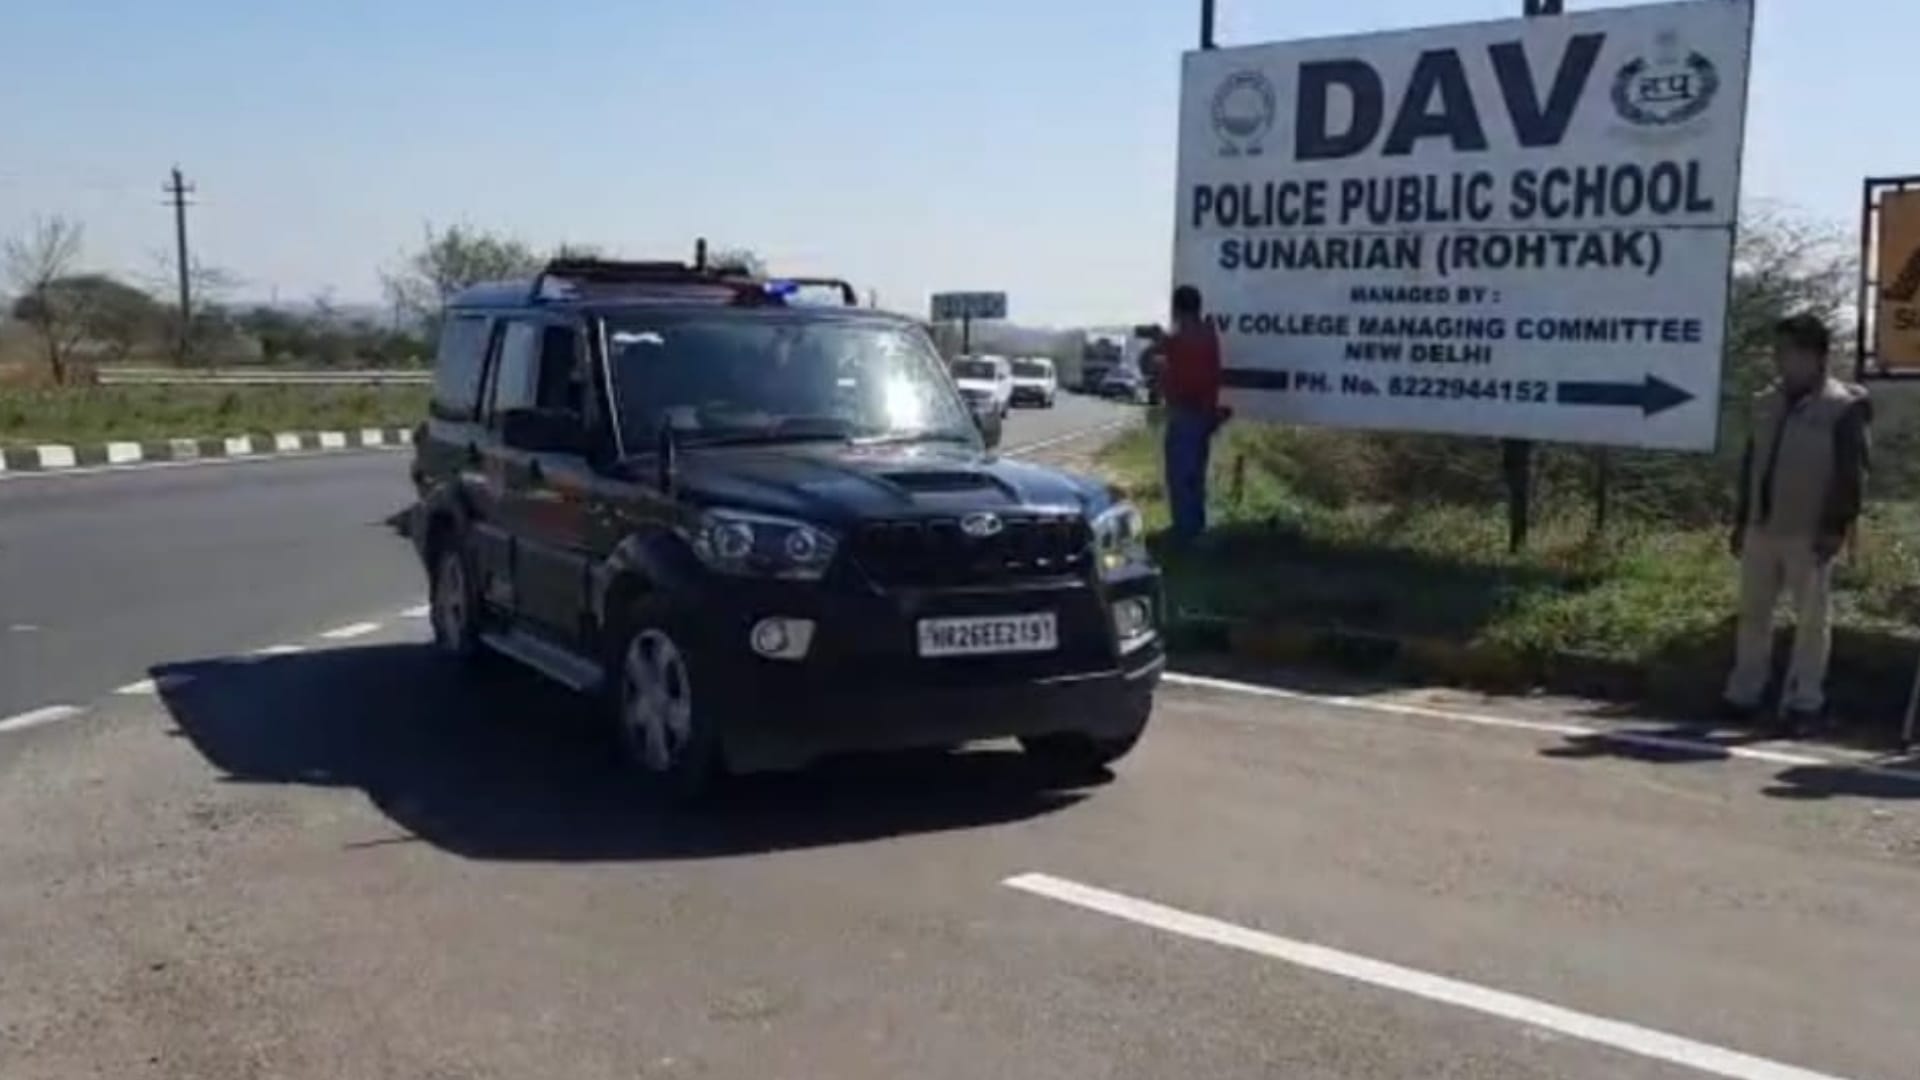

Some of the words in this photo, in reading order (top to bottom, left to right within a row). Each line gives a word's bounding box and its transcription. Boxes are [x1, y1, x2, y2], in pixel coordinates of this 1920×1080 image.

[1295, 32, 1606, 161] DAV
[1193, 180, 1327, 228] POLICE
[1340, 172, 1494, 223] PUBLIC
[1509, 160, 1714, 220] SCHOOL
[1219, 236, 1422, 270] SUNARIAN
[1436, 231, 1662, 276] (ROHTAK)
[1351, 286, 1450, 303] MANAGED
[1457, 287, 1487, 303] BY
[1238, 313, 1350, 336] COLLEGE
[1358, 316, 1505, 340] MANAGING
[1515, 317, 1702, 342] COMMITTEE
[1345, 342, 1401, 362] NEW
[1409, 344, 1492, 364] DELHI
[1295, 372, 1332, 392] PH.
[1341, 375, 1379, 395] No.
